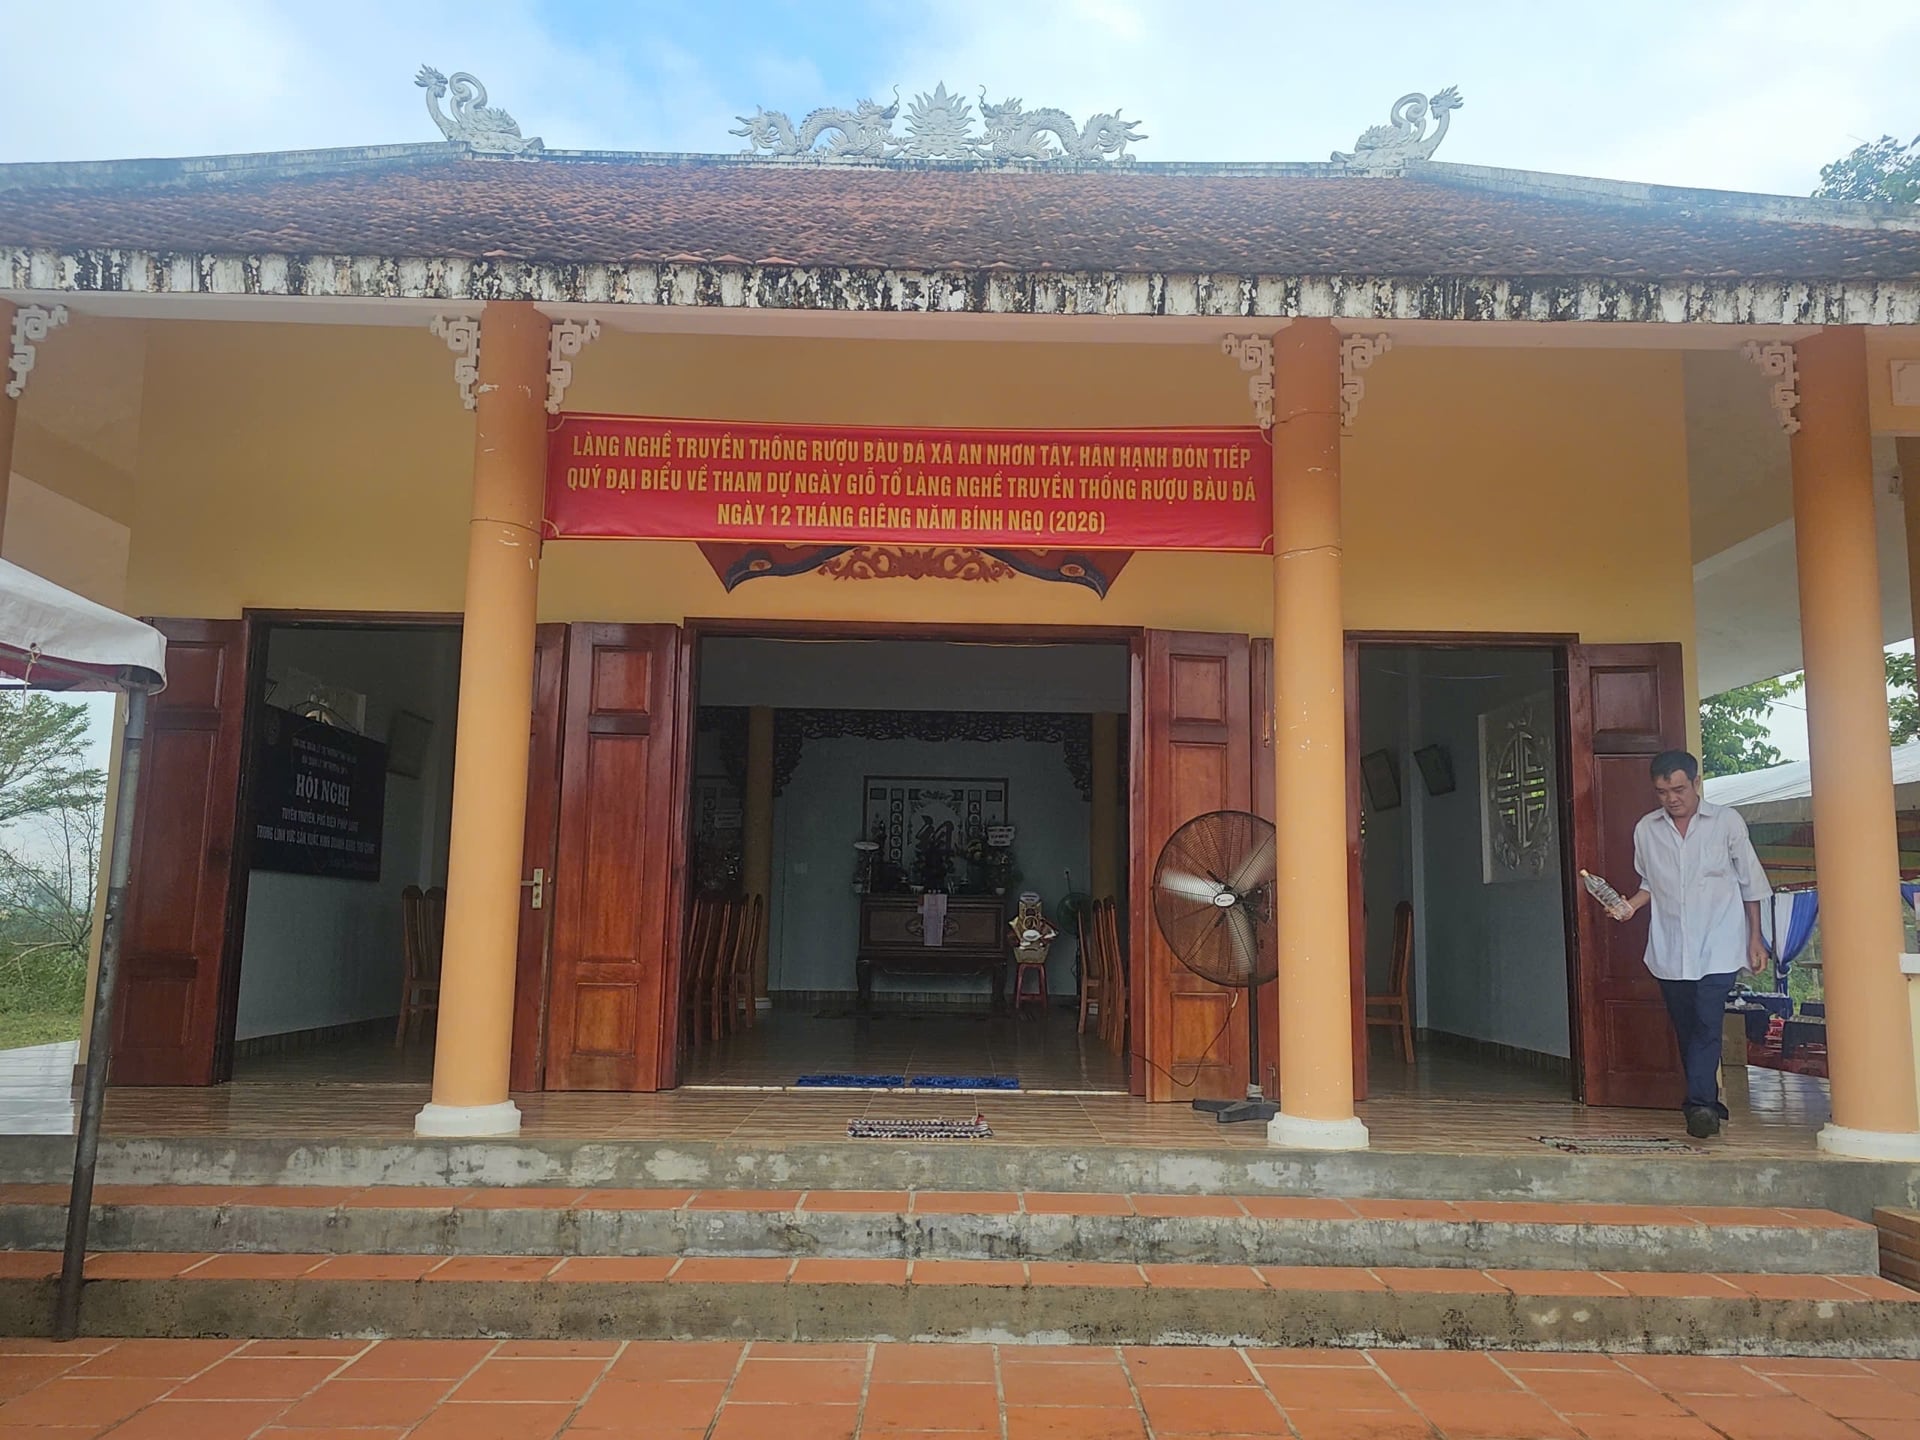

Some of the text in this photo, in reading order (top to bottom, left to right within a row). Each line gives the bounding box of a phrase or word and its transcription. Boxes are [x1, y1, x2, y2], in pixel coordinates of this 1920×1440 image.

[573, 432, 619, 456] LÀNG
[625, 430, 671, 457] NGHỀ
[677, 432, 744, 459] TRUYỀN
[750, 434, 806, 461] THỐNG
[812, 439, 858, 466] RƯỢU
[864, 439, 897, 462] BÀU
[903, 440, 925, 463] ĐÁ
[931, 441, 953, 464] XÃ
[958, 444, 981, 465] AN
[987, 443, 1035, 466] NHƠN
[1079, 443, 1114, 467] HÂN
[1120, 447, 1167, 472] HẠNH
[1172, 444, 1207, 468] ĐÓN
[1213, 443, 1251, 469] TIẾP
[567, 461, 1256, 505] QUÝ ĐẠI BIỂU VỀ THAM DỰ NGÀY GIỖ TỔ LÀNG NGHỀ TRUYỀN THỐNG RƯỢU BÀU ĐÁ
[717, 500, 1105, 536] NGÀY 12 THÁNG GIÊNG NĂM BÍNH NGỌ (2026)
[296, 771, 350, 811] HỘI NGHỊ
